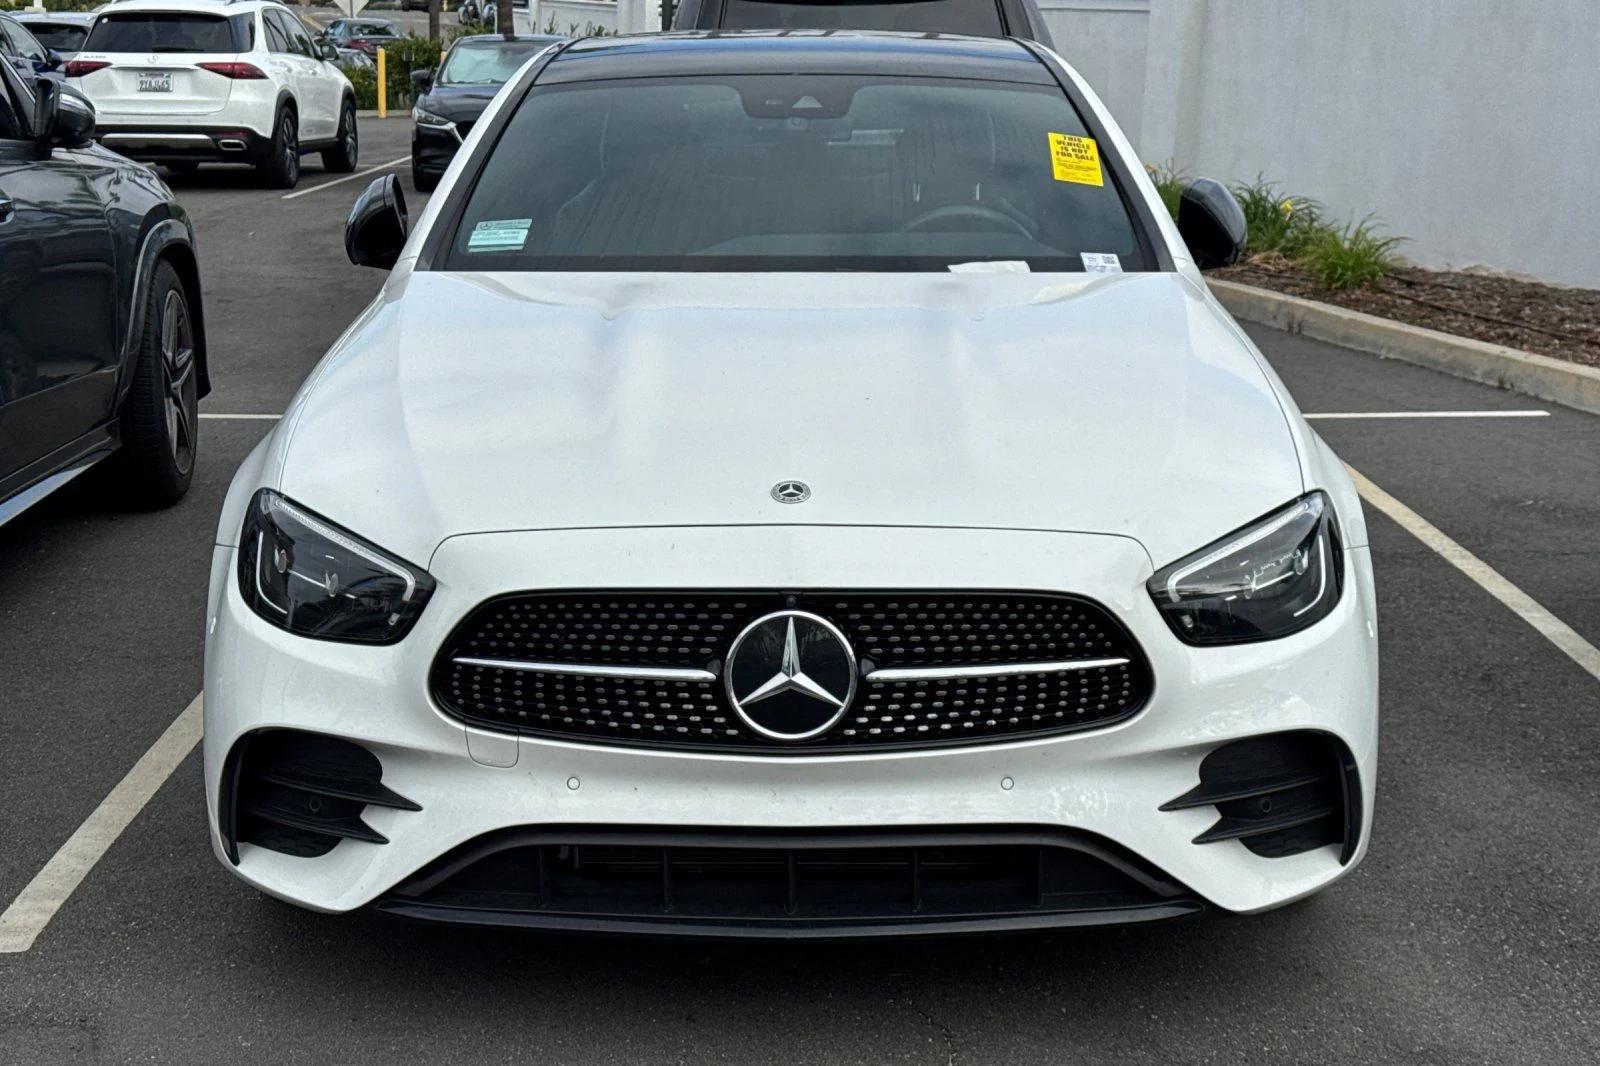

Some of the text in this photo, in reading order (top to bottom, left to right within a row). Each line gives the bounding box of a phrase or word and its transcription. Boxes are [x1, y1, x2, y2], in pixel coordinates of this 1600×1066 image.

[1056, 139, 1090, 150] VEHICLE
[1063, 135, 1083, 143] THIS
[1056, 150, 1073, 158] FOR
[1074, 153, 1095, 161] SALE
